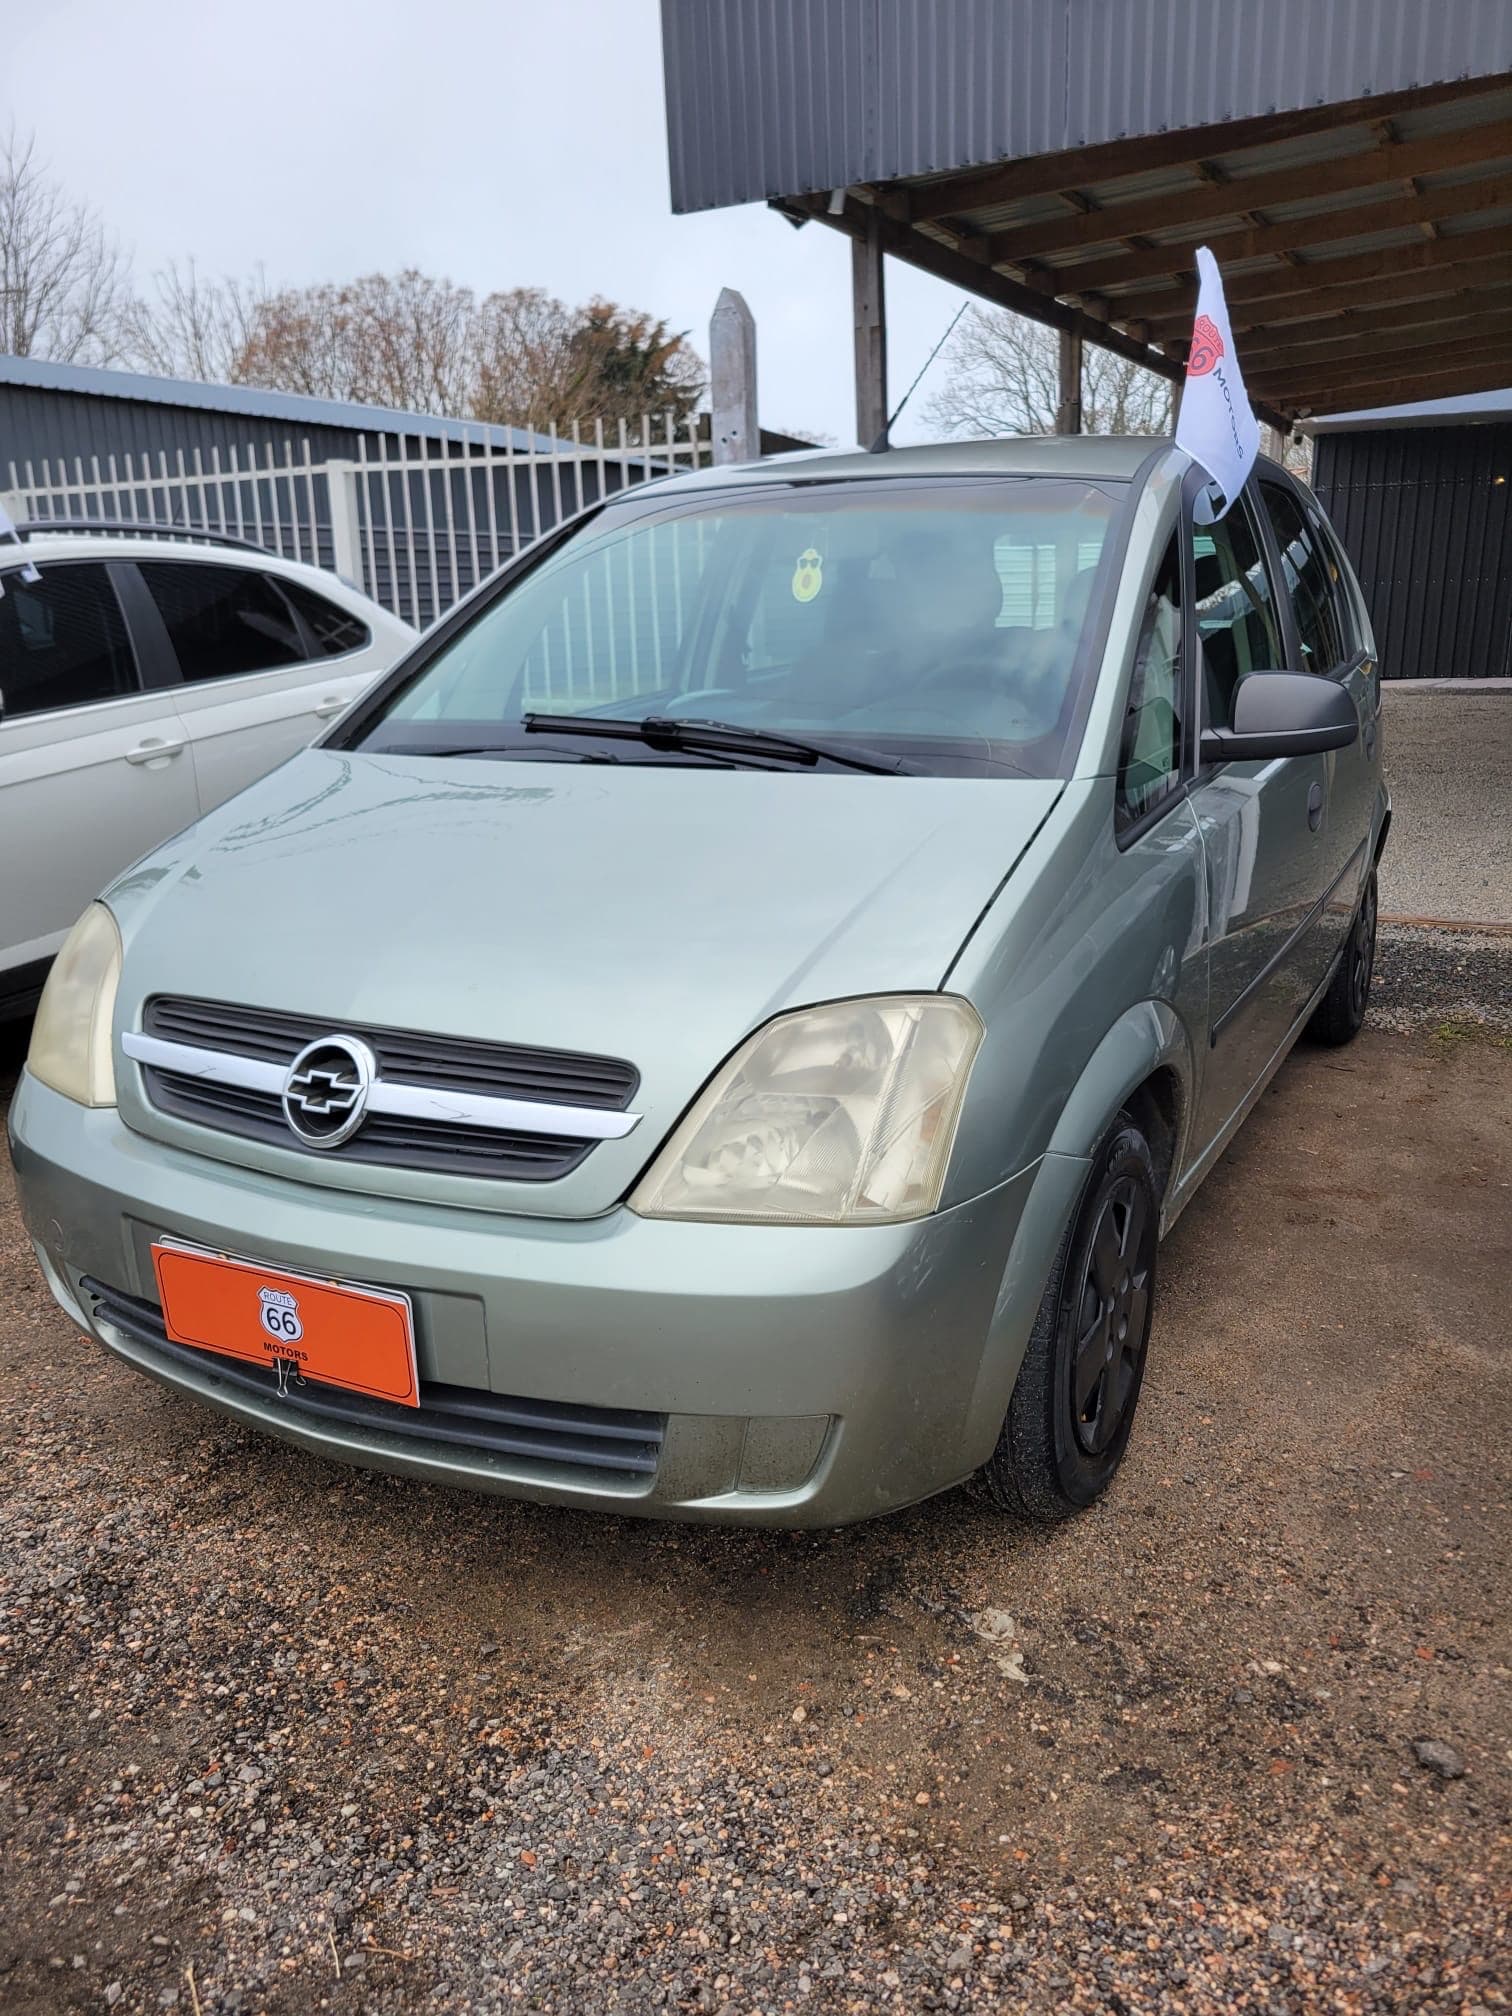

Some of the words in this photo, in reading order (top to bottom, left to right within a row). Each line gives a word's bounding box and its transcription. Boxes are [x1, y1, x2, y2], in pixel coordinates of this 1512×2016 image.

[263, 1291, 293, 1306] ROUTE
[266, 1307, 297, 1335] 66
[263, 1342, 309, 1361] MOTORS
